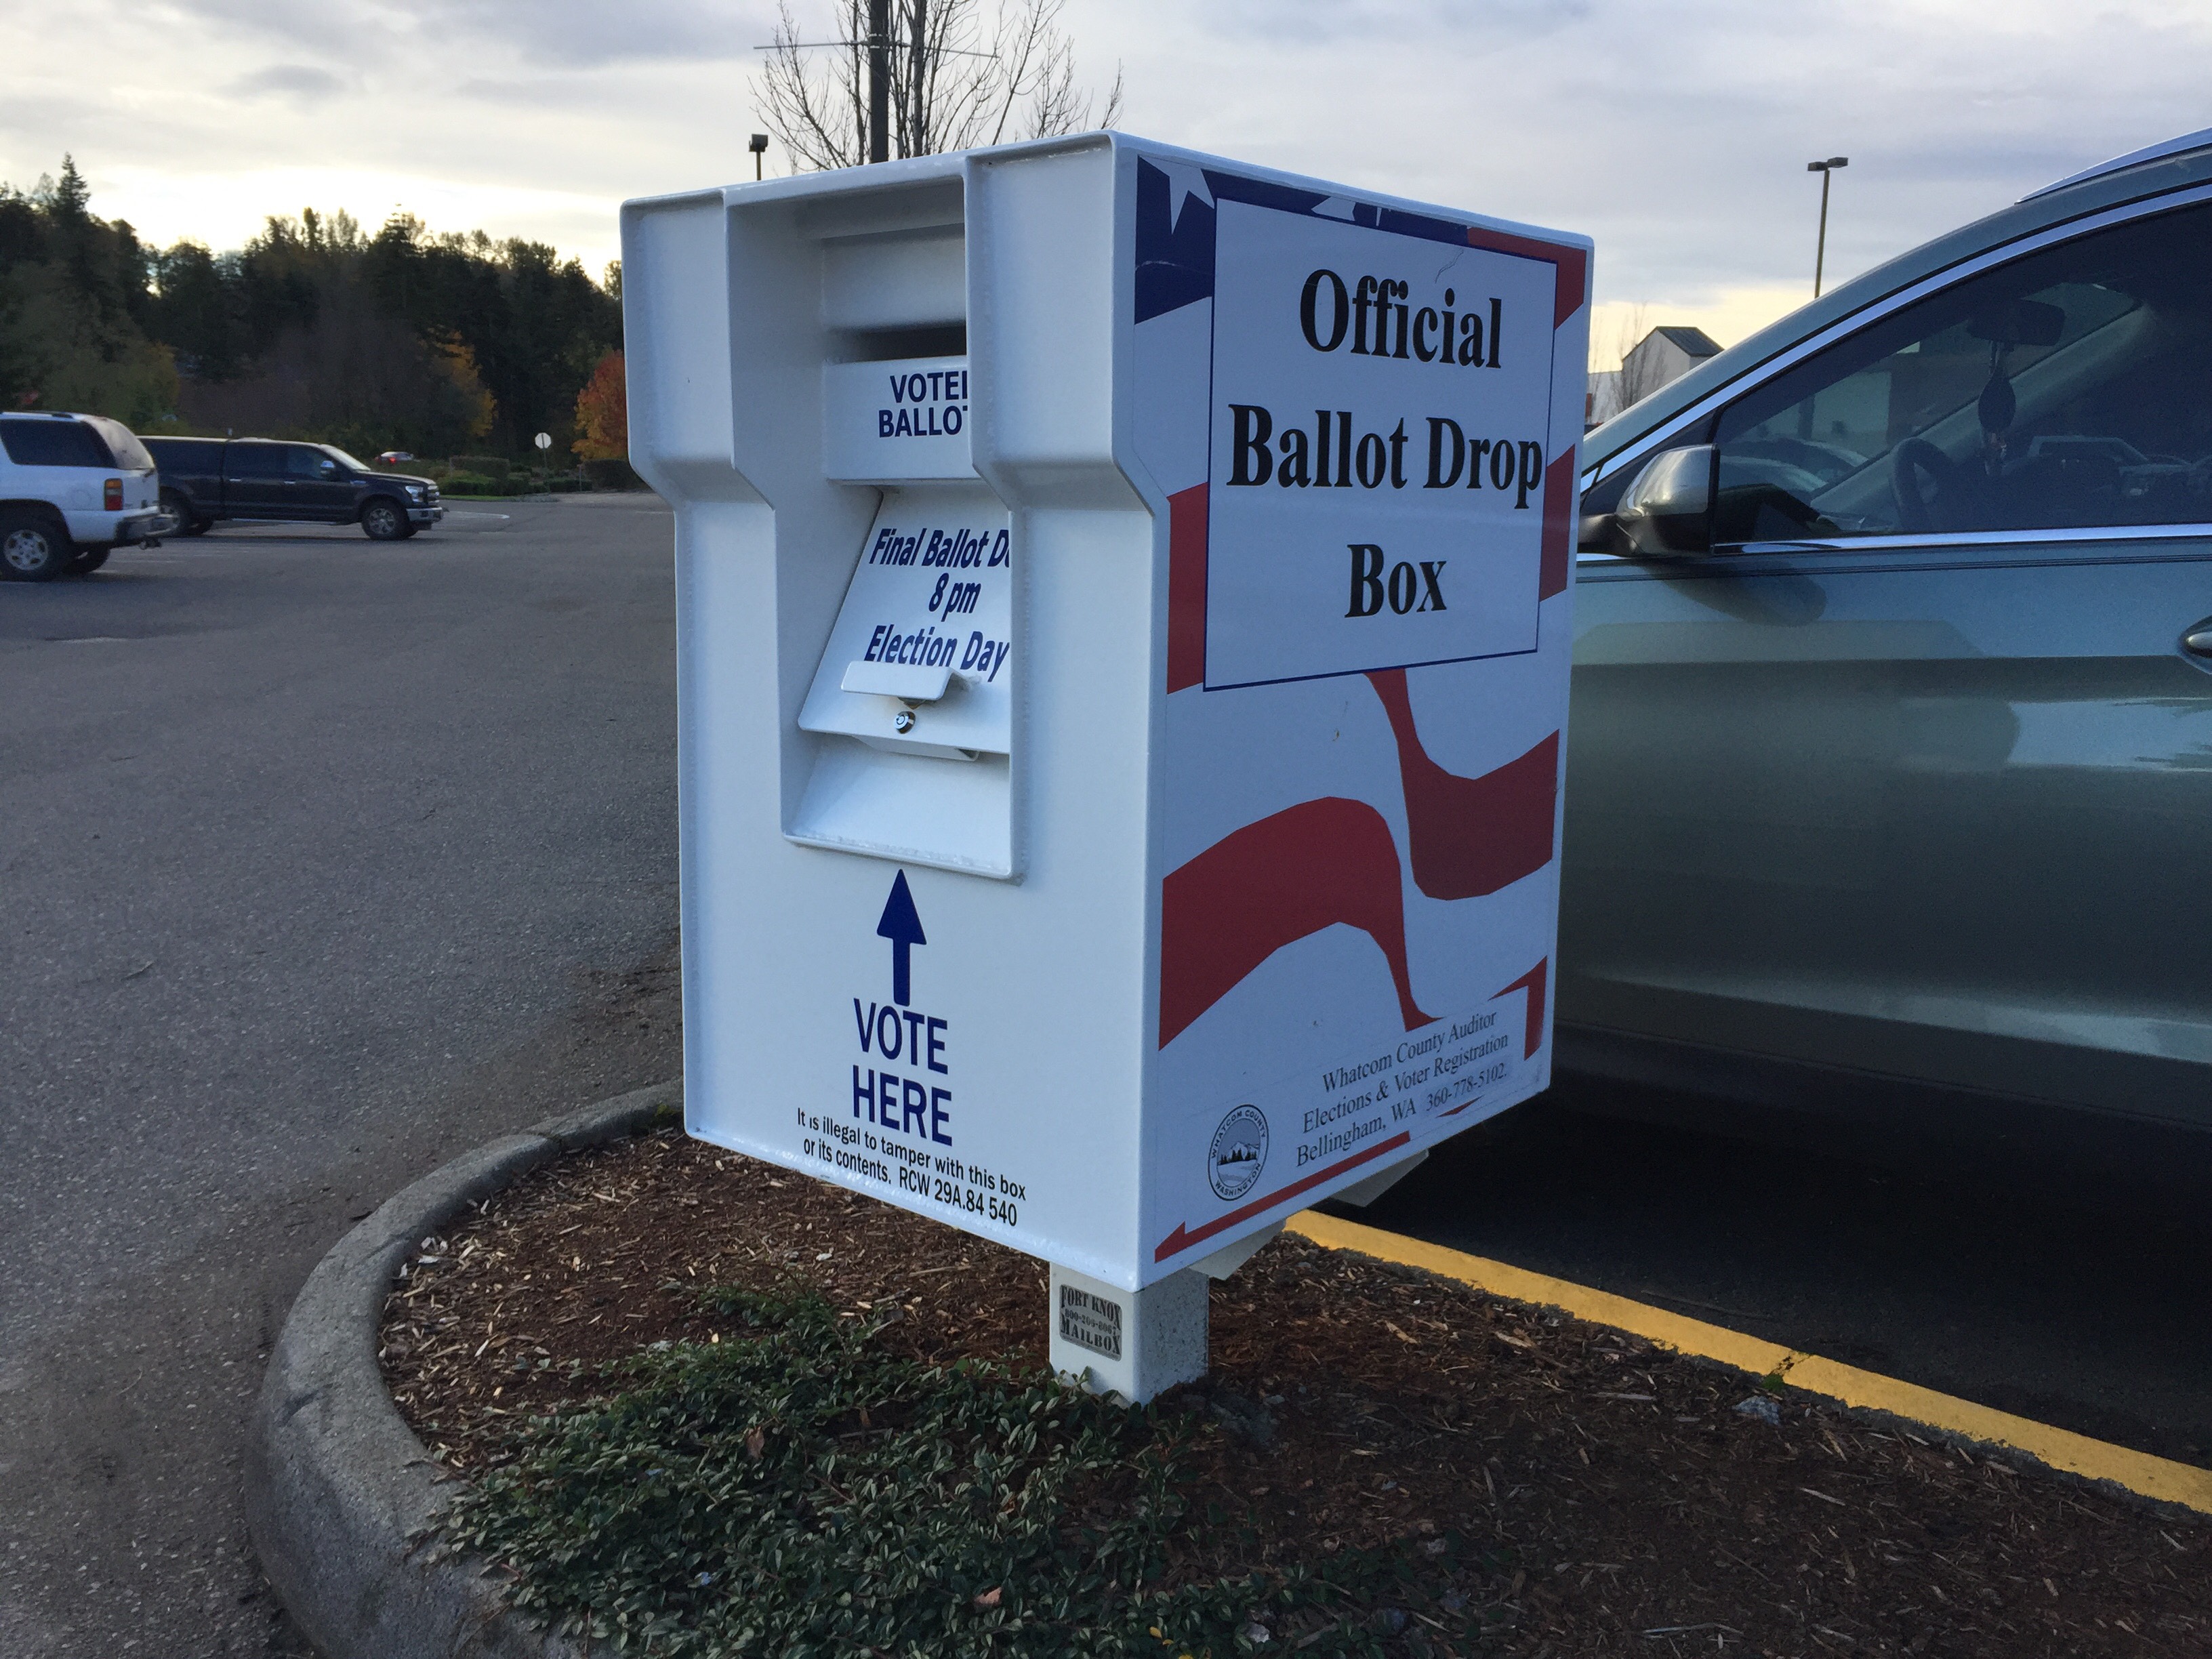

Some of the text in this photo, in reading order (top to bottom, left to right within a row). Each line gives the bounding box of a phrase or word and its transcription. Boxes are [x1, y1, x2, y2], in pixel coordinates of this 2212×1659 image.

[1300, 269, 1502, 369] Official
[1227, 404, 1542, 509] Ballot Drop
[869, 528, 926, 565] Final
[922, 529, 989, 568] Ballot
[1345, 544, 1447, 617] Box
[928, 573, 982, 622] 8 pm
[864, 624, 1010, 682] Election Day
[853, 998, 948, 1075] VOTE
[1322, 1012, 1497, 1093] Whatcom County Auditor
[853, 1065, 952, 1147] HERE
[1303, 1033, 1509, 1134] Elections & Voter Registration
[798, 1107, 1027, 1202] It is illegal to tamper with this box
[1296, 1115, 1387, 1167] Bellingham,
[1391, 1098, 1416, 1122] WA
[804, 1138, 815, 1156] or
[819, 1138, 833, 1163] its
[836, 1149, 892, 1185] contents.
[899, 1166, 930, 1197] RCW
[989, 1196, 1018, 1227] 540
[1215, 1163, 1261, 1197] WASHINGTON
[1061, 1285, 1121, 1331] FORT KNOX
[1061, 1313, 1121, 1355] MAILBOX
